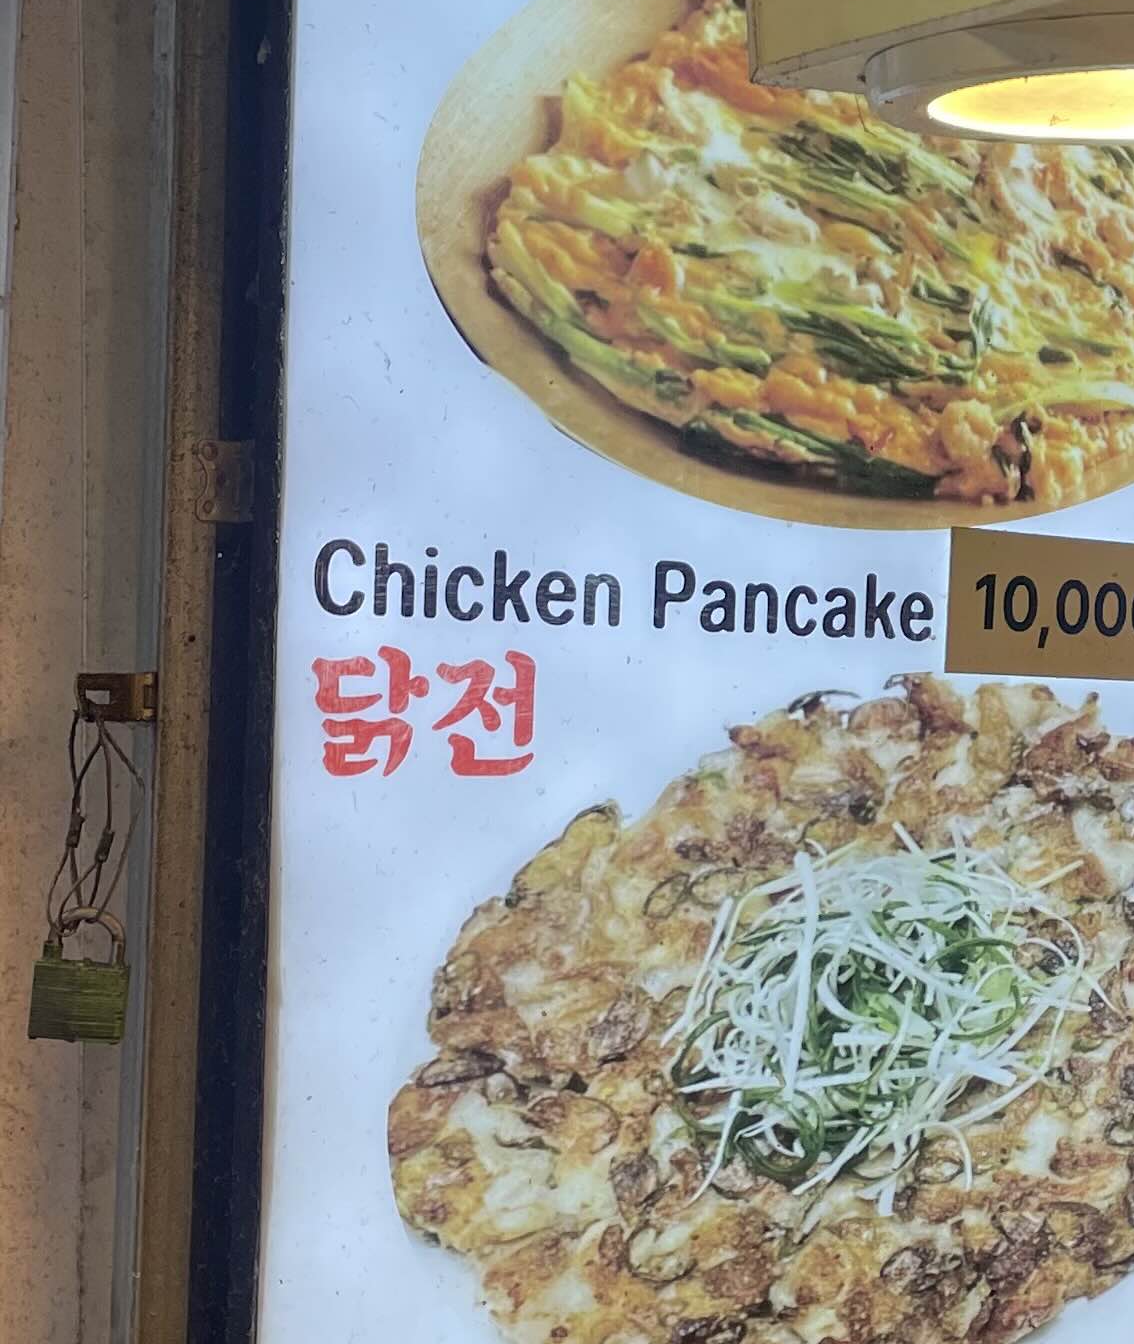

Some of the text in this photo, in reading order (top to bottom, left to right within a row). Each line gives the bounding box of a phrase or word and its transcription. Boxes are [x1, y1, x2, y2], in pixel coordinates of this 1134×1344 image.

[312, 538, 935, 643] Chicken Pancake
[311, 644, 537, 778] 닭전
